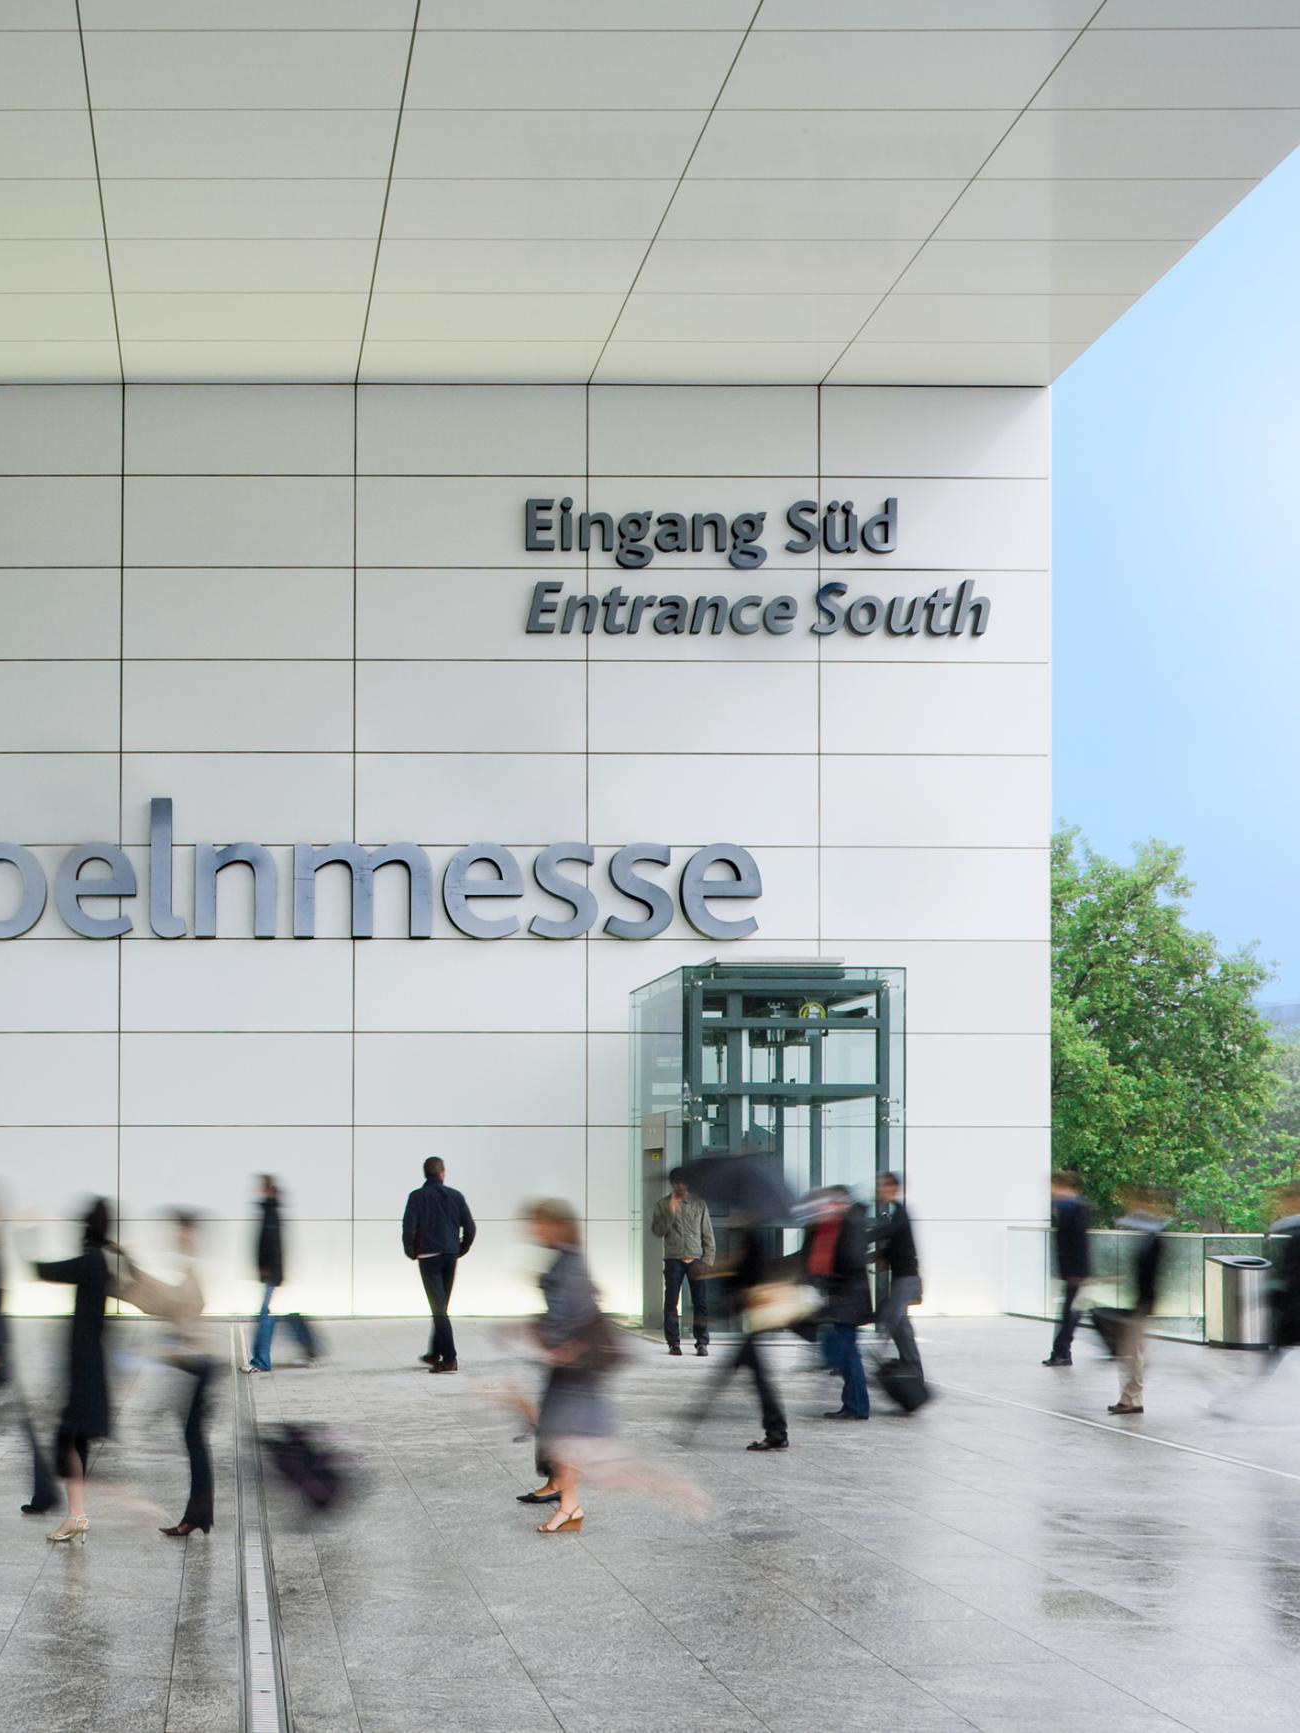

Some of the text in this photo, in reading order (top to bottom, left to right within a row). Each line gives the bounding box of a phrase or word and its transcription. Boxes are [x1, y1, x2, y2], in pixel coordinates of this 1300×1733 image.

[525, 497, 898, 569] Eingang Süd
[525, 579, 991, 636] Entrance South
